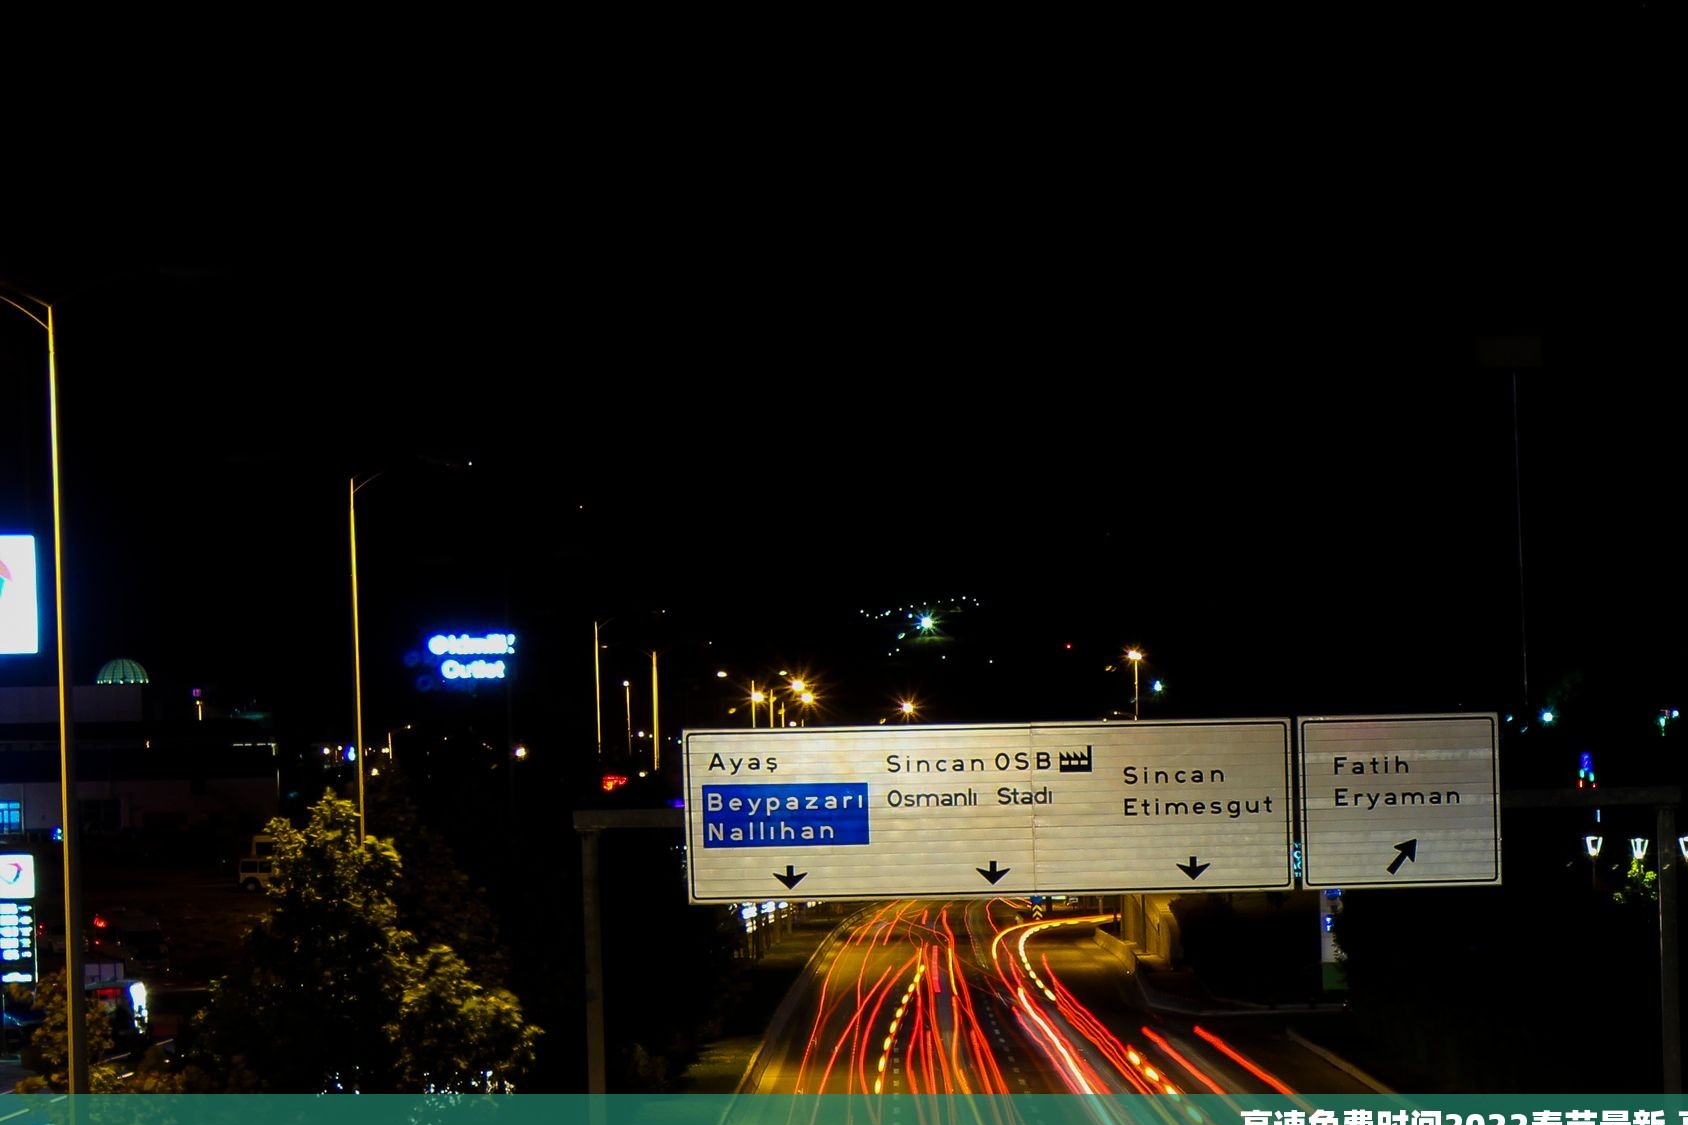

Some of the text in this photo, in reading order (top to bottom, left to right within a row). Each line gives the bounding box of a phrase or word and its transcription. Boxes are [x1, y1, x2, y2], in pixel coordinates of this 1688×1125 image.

[708, 752, 778, 775] Ayaş
[886, 751, 1052, 773] Sincan OSB
[1333, 755, 1410, 776] Fatih
[1122, 766, 1226, 785] Sincan
[707, 793, 864, 817] Beypazarı
[887, 786, 1054, 808] Osmanlı Stadı
[1122, 795, 1274, 819] Etimesgut
[1334, 787, 1461, 811] Eryaman
[707, 821, 835, 841] Nallıhan
